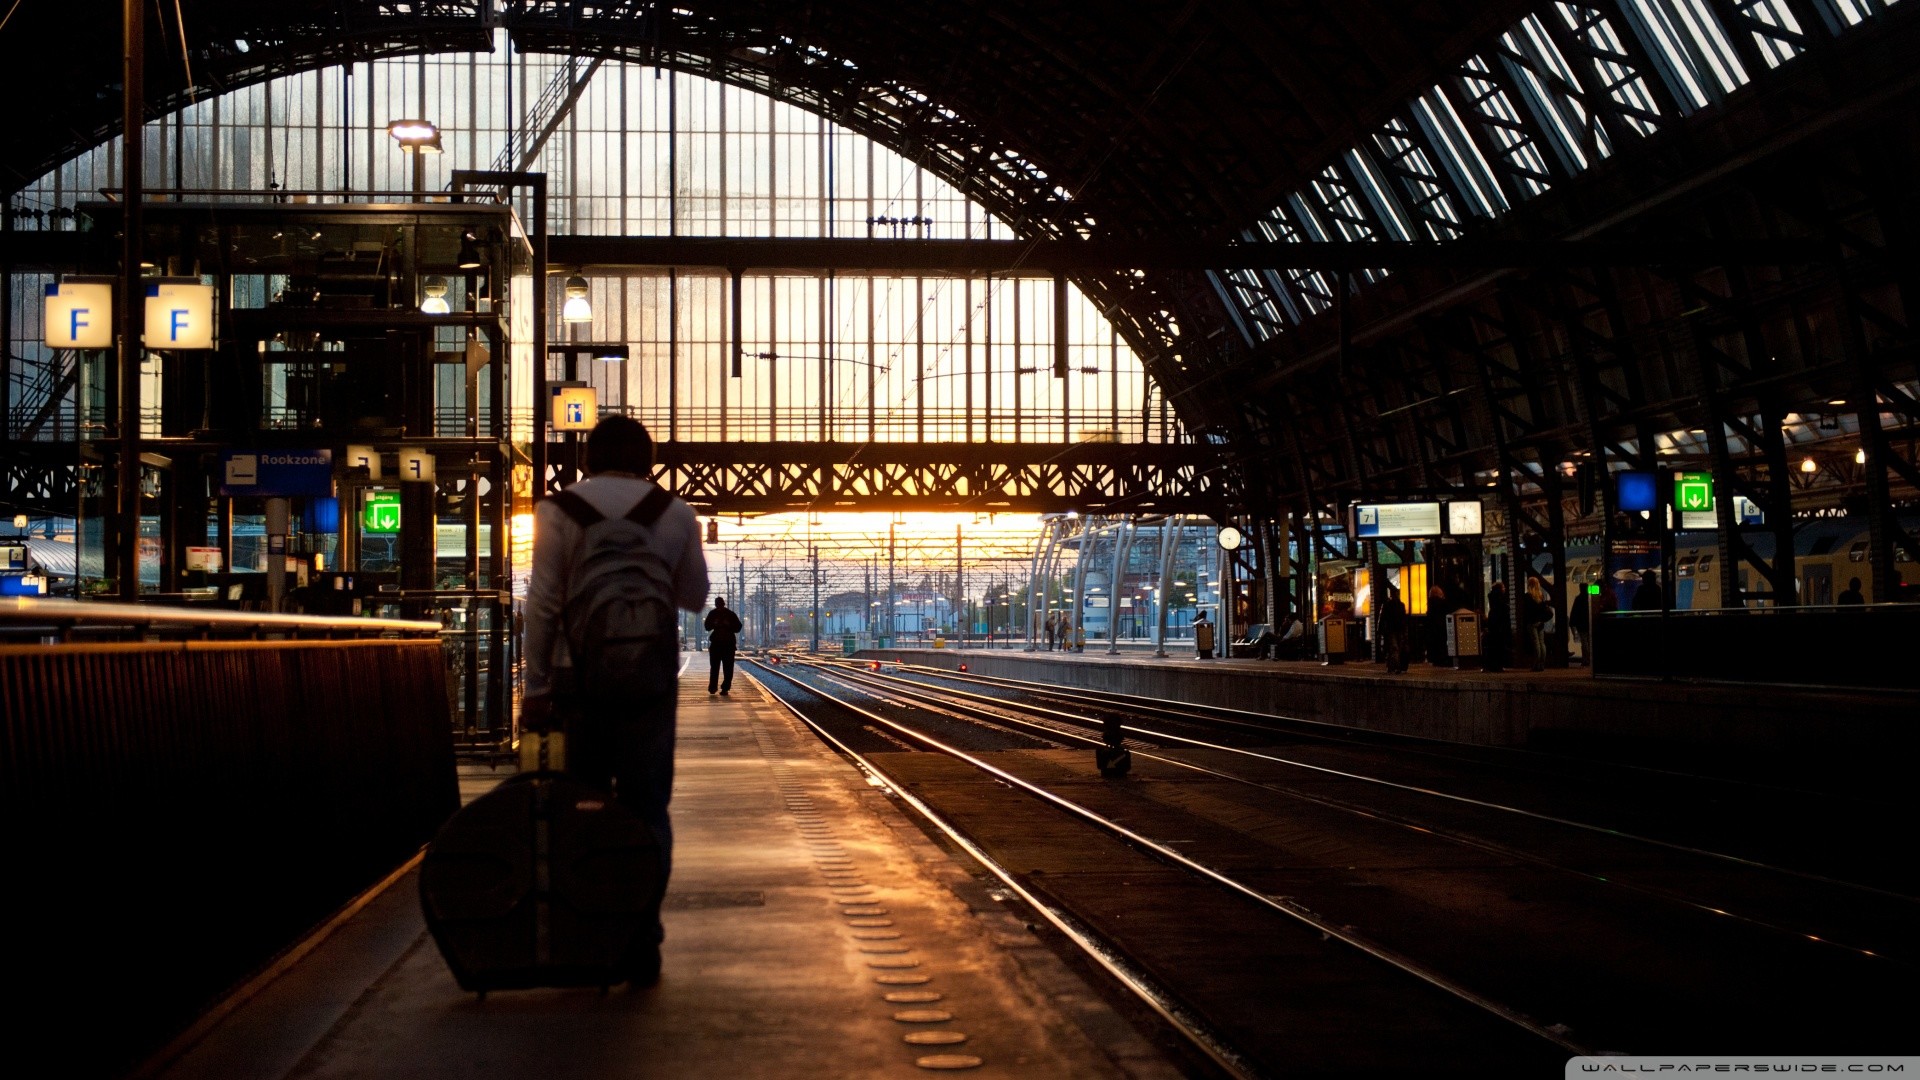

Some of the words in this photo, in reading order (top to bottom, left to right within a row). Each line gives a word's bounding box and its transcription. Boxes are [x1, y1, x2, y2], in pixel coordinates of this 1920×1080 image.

[70, 308, 90, 341] F
[170, 309, 190, 341] F
[261, 454, 327, 465] Rookzone
